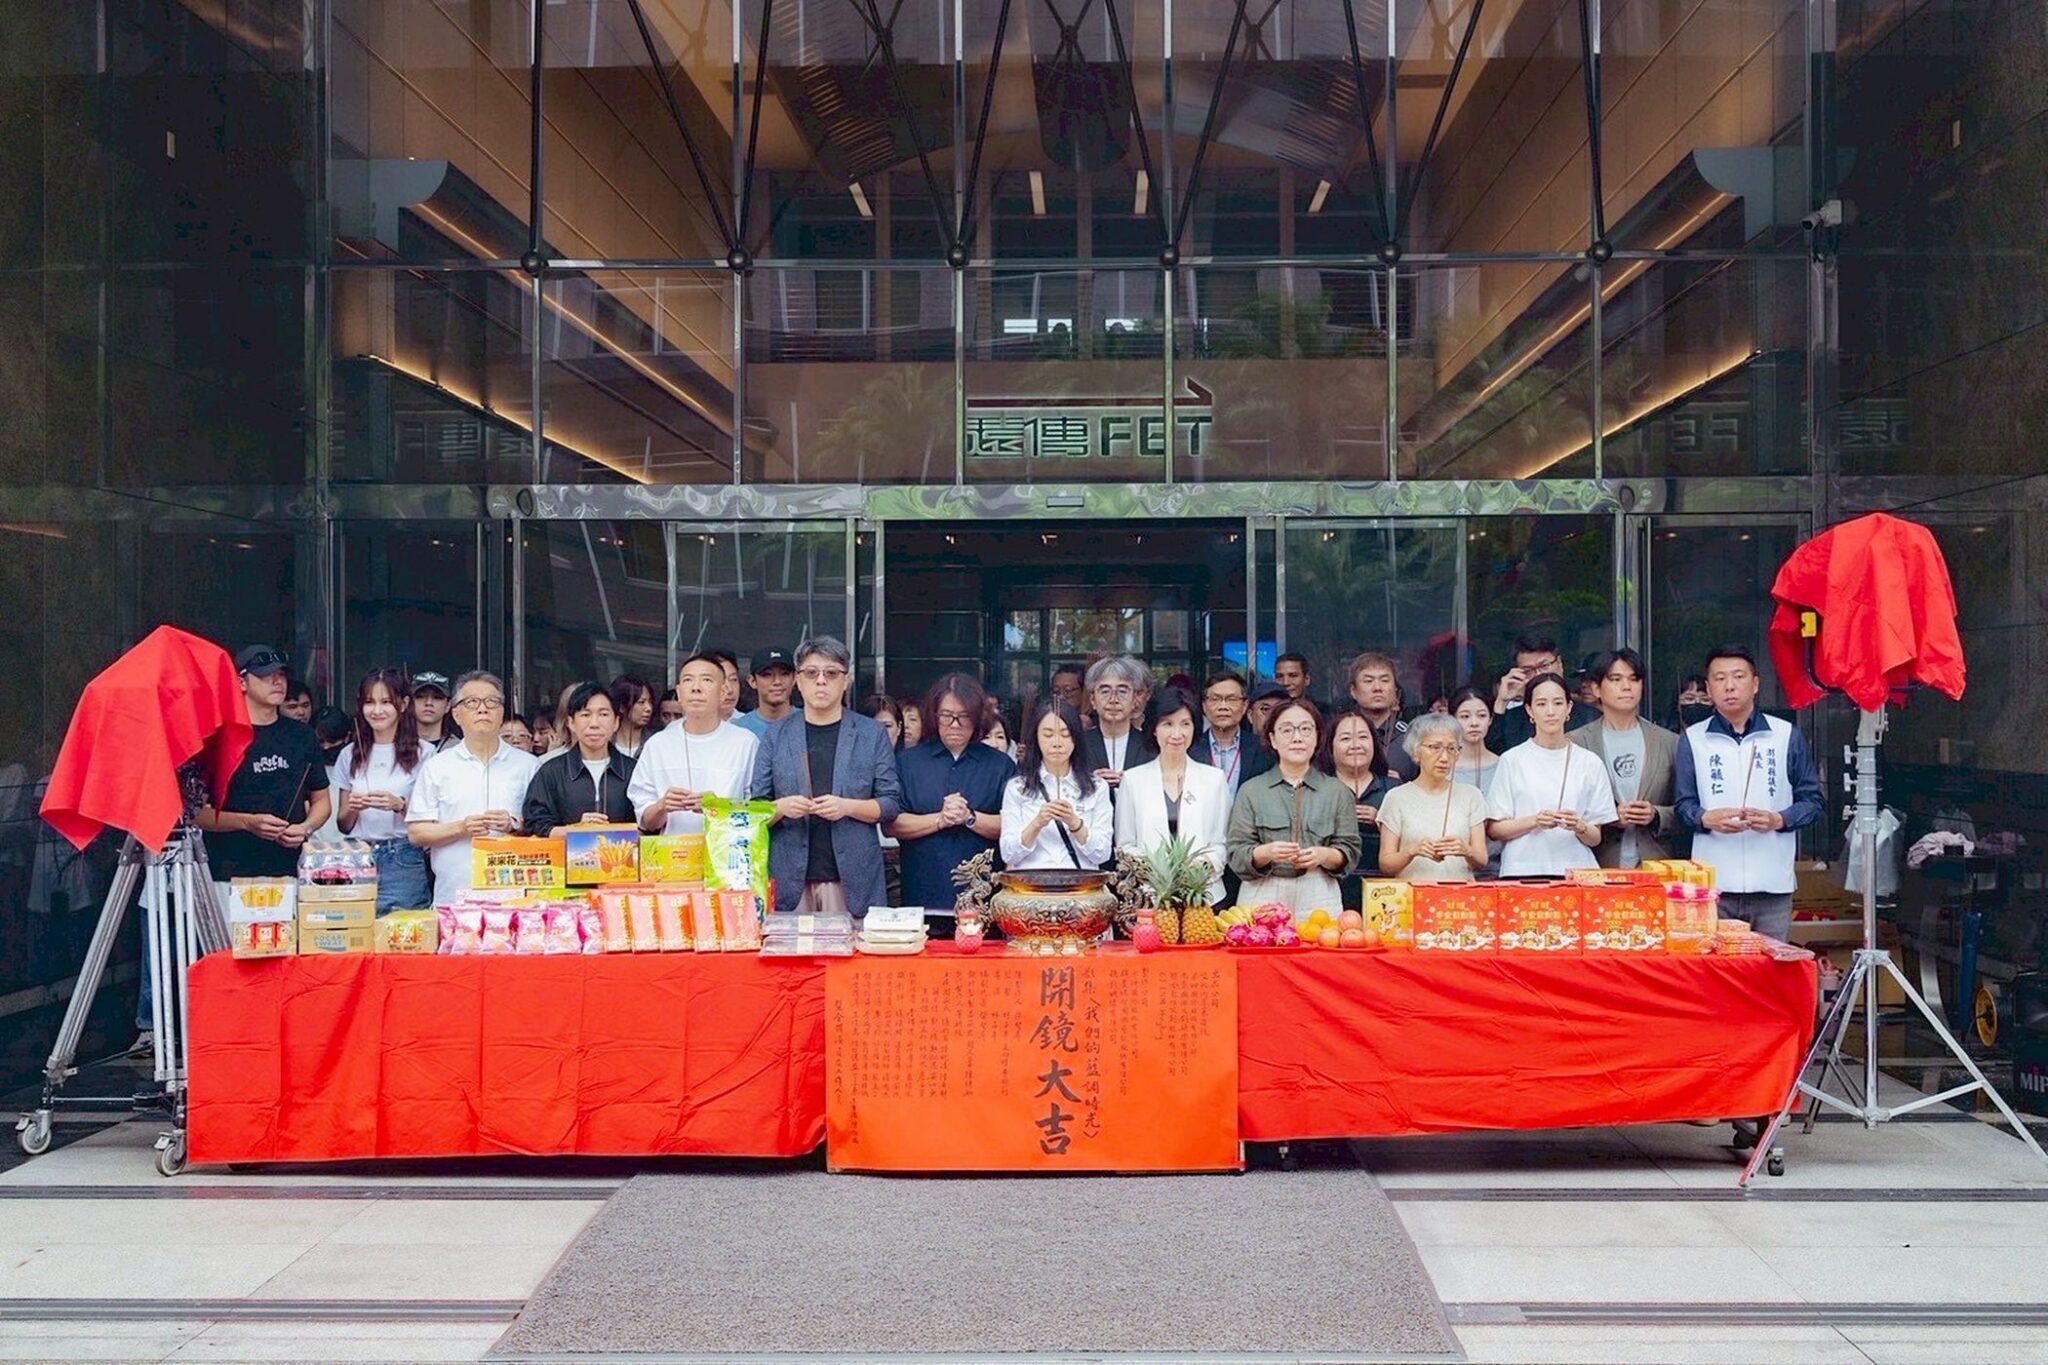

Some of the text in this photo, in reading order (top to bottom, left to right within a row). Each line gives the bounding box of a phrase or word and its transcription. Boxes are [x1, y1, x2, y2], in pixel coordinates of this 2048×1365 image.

[967, 416, 1213, 457] 遠傳 FET
[1029, 965, 1083, 1156] 開鏡大吉
